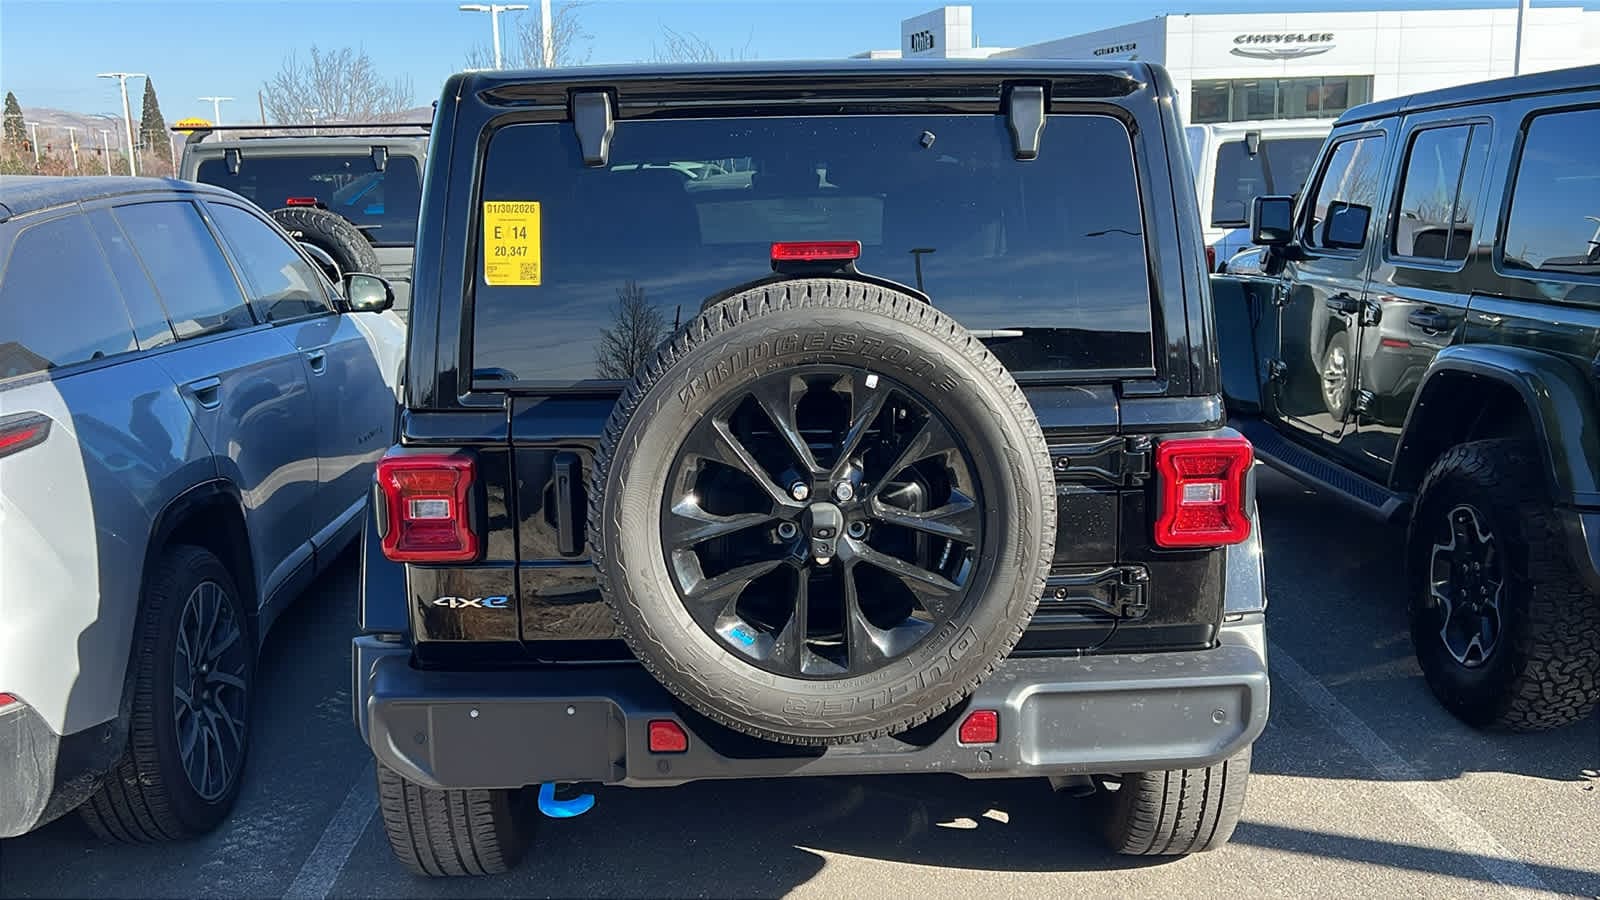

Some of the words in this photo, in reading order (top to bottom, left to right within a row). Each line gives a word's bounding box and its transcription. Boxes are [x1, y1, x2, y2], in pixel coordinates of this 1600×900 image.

[1233, 32, 1335, 44] CHRYSLER
[487, 204, 535, 213] 01/30/2026
[494, 226, 503, 240] E
[512, 226, 527, 240] 14
[678, 331, 960, 413] BRIDGESTONE
